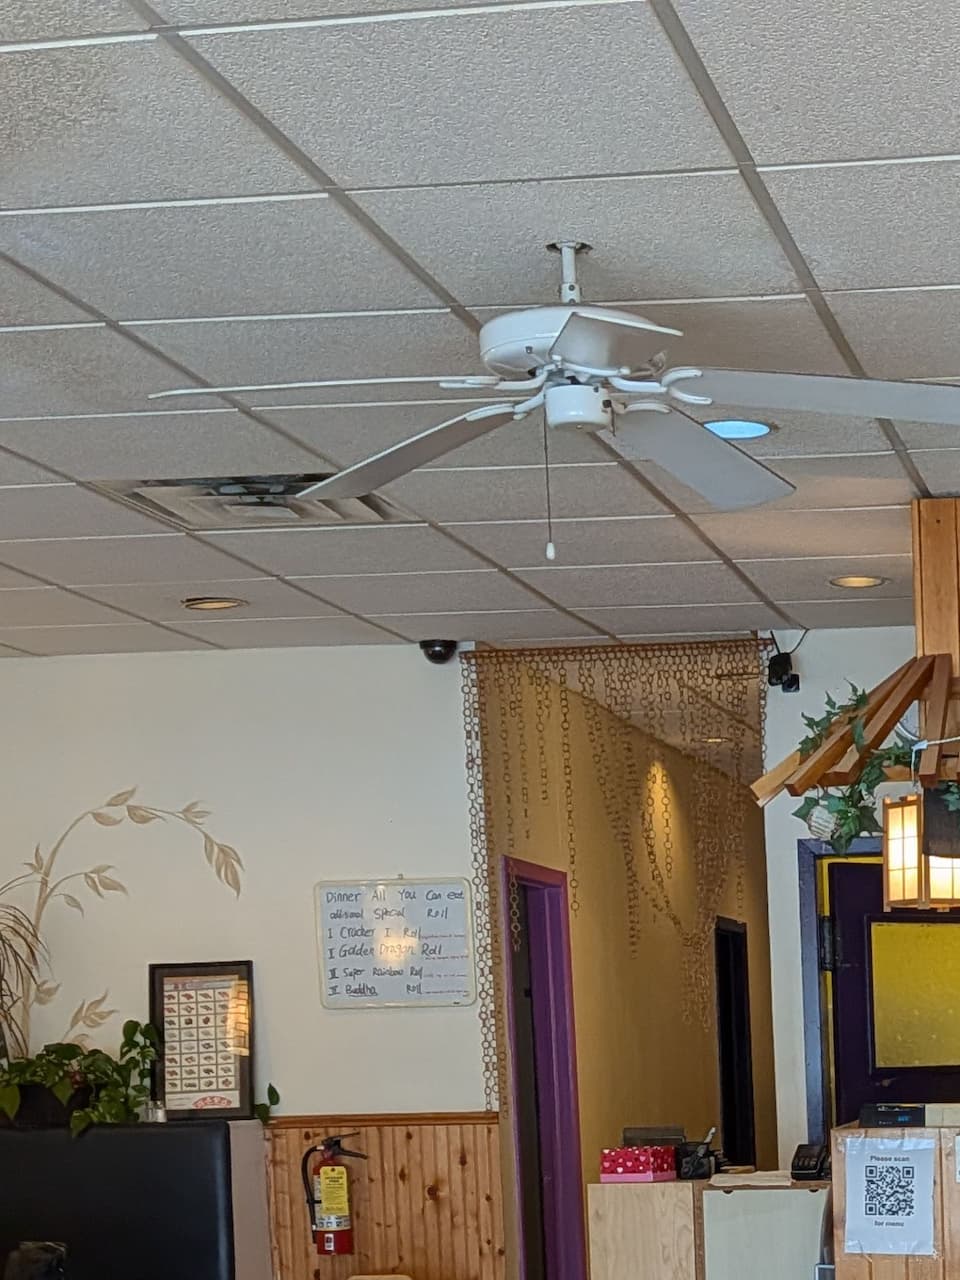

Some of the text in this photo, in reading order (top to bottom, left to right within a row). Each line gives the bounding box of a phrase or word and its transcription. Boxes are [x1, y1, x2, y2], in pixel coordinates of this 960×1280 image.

[326, 891, 362, 904] Dinner
[372, 888, 387, 901] All
[399, 888, 417, 900] You
[425, 889, 442, 901] Can
[426, 907, 449, 920] Roll
[421, 942, 443, 956] Roll
